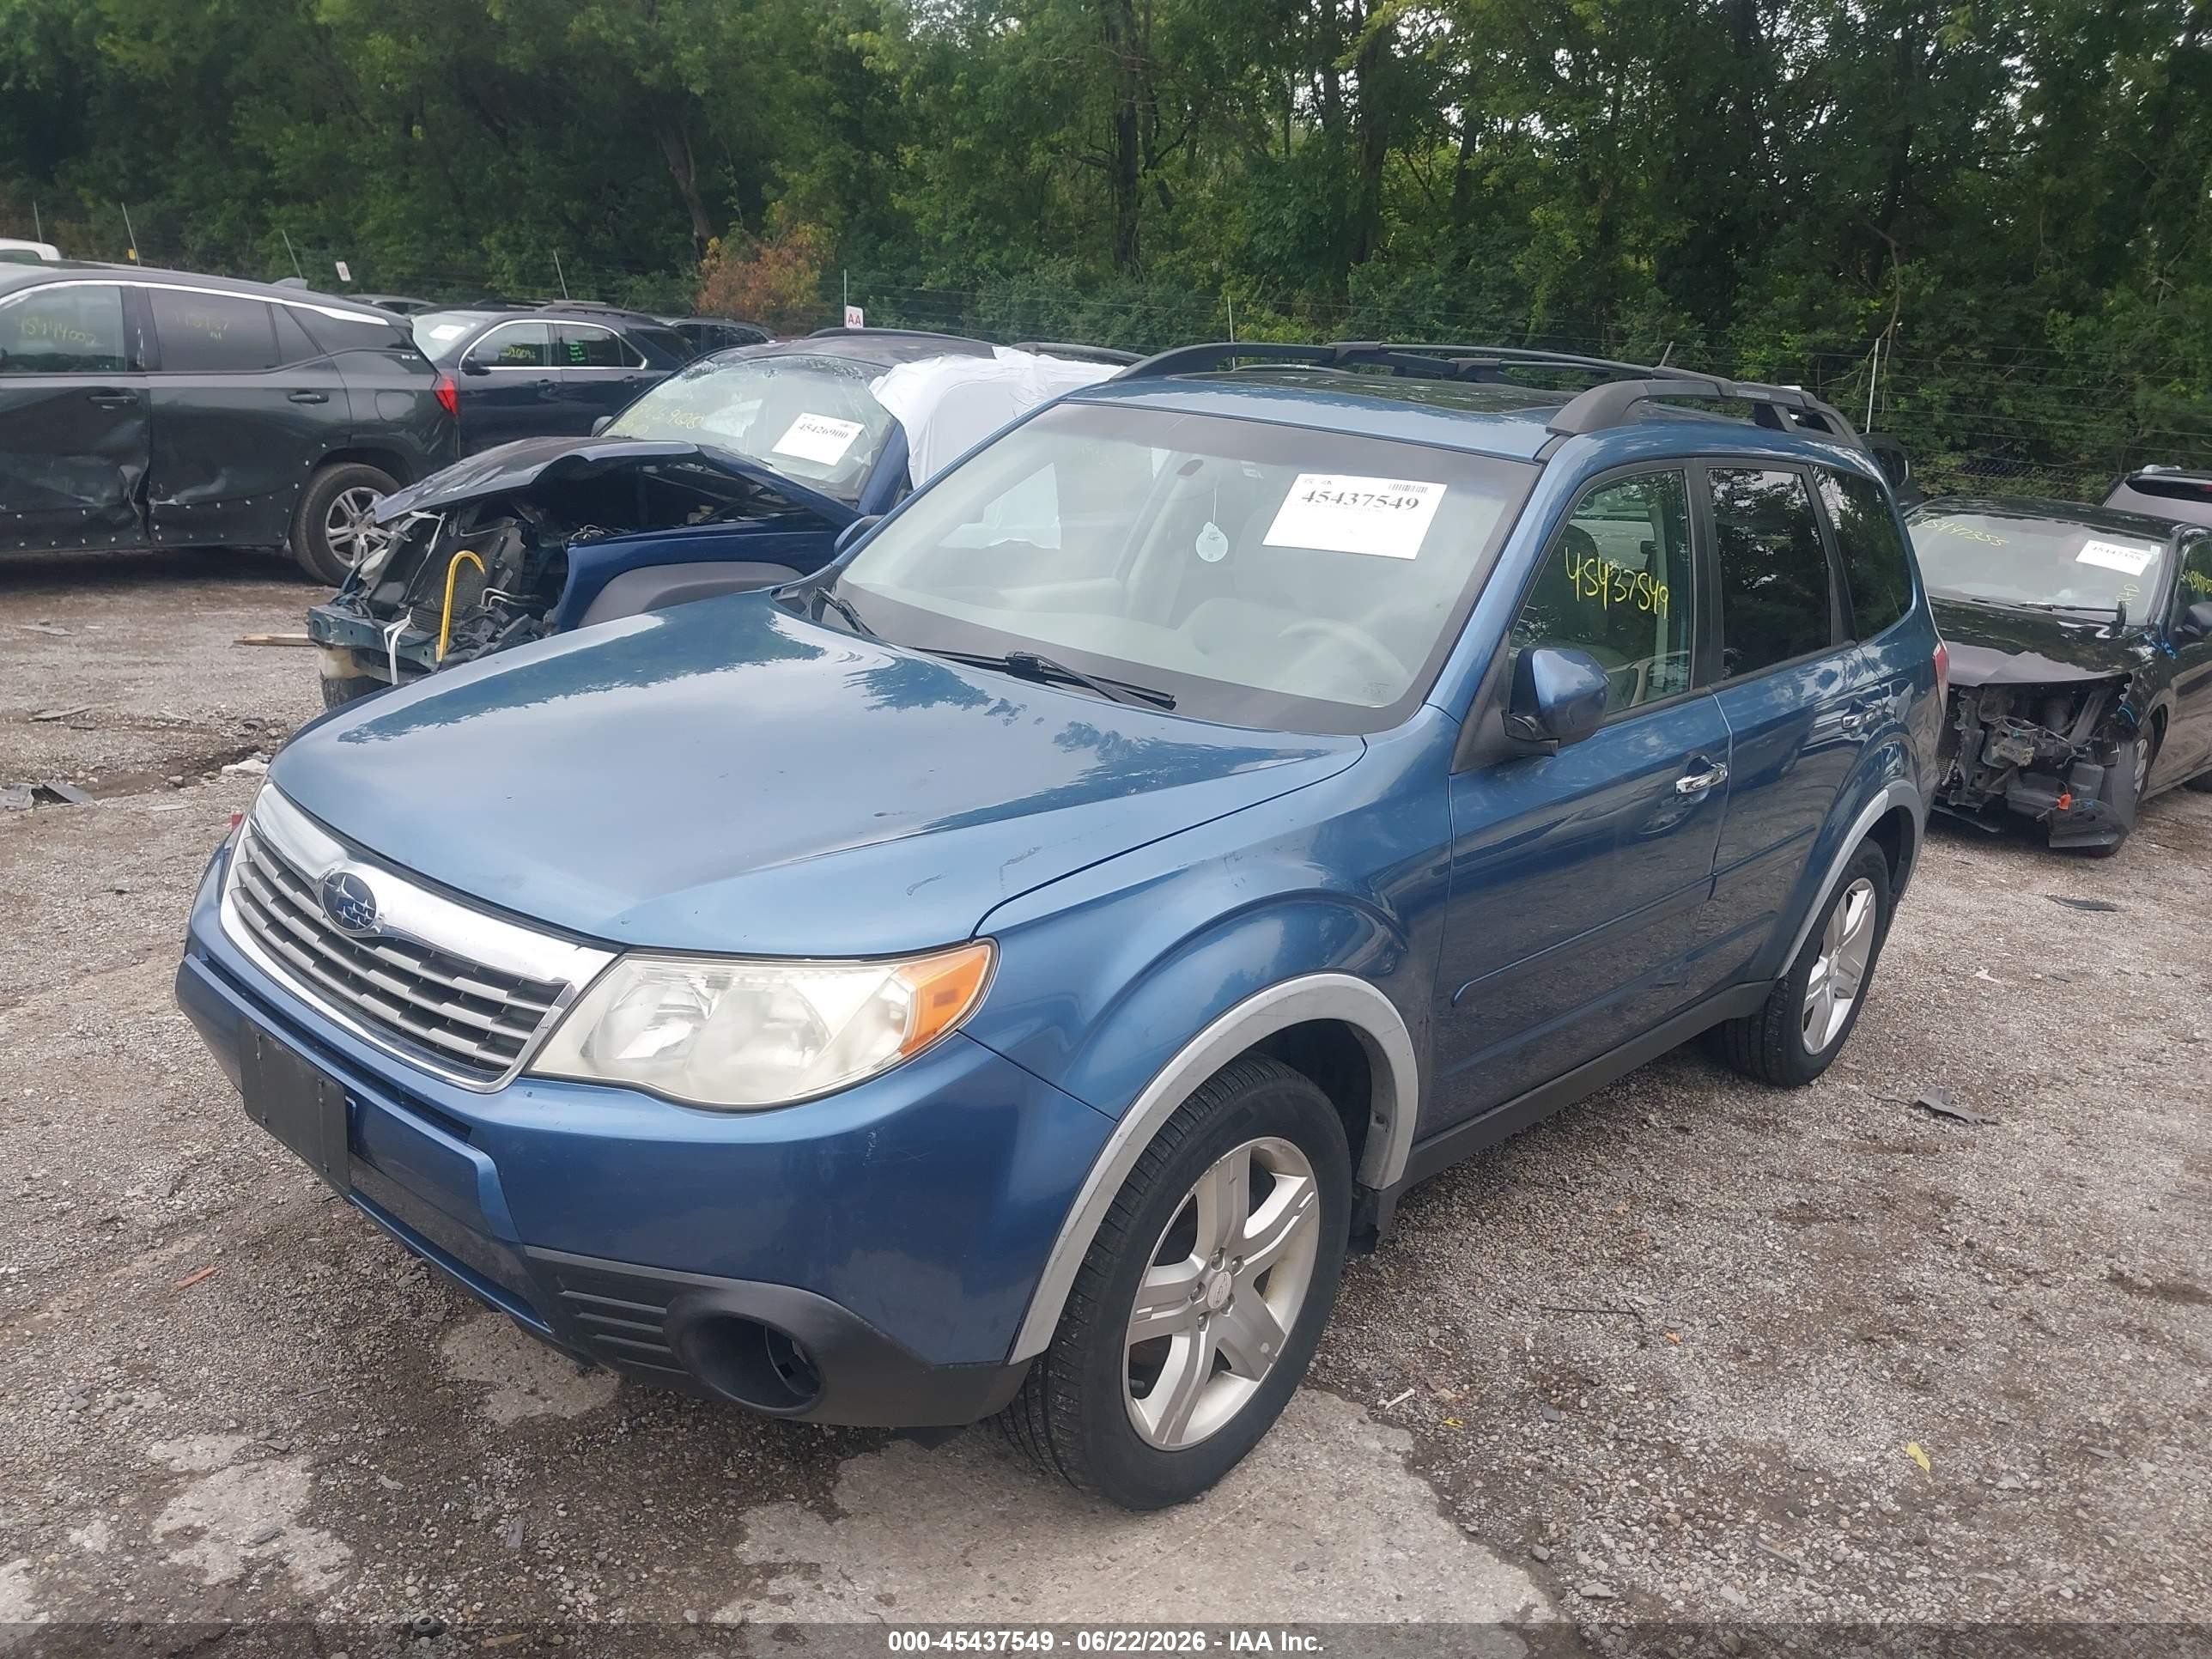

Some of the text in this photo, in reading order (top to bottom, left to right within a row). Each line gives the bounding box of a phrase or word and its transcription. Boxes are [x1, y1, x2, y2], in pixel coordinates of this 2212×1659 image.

[799, 423, 848, 439] 45426900
[1301, 489, 1420, 511] 45437549
[1565, 546, 1669, 619] 45437549
